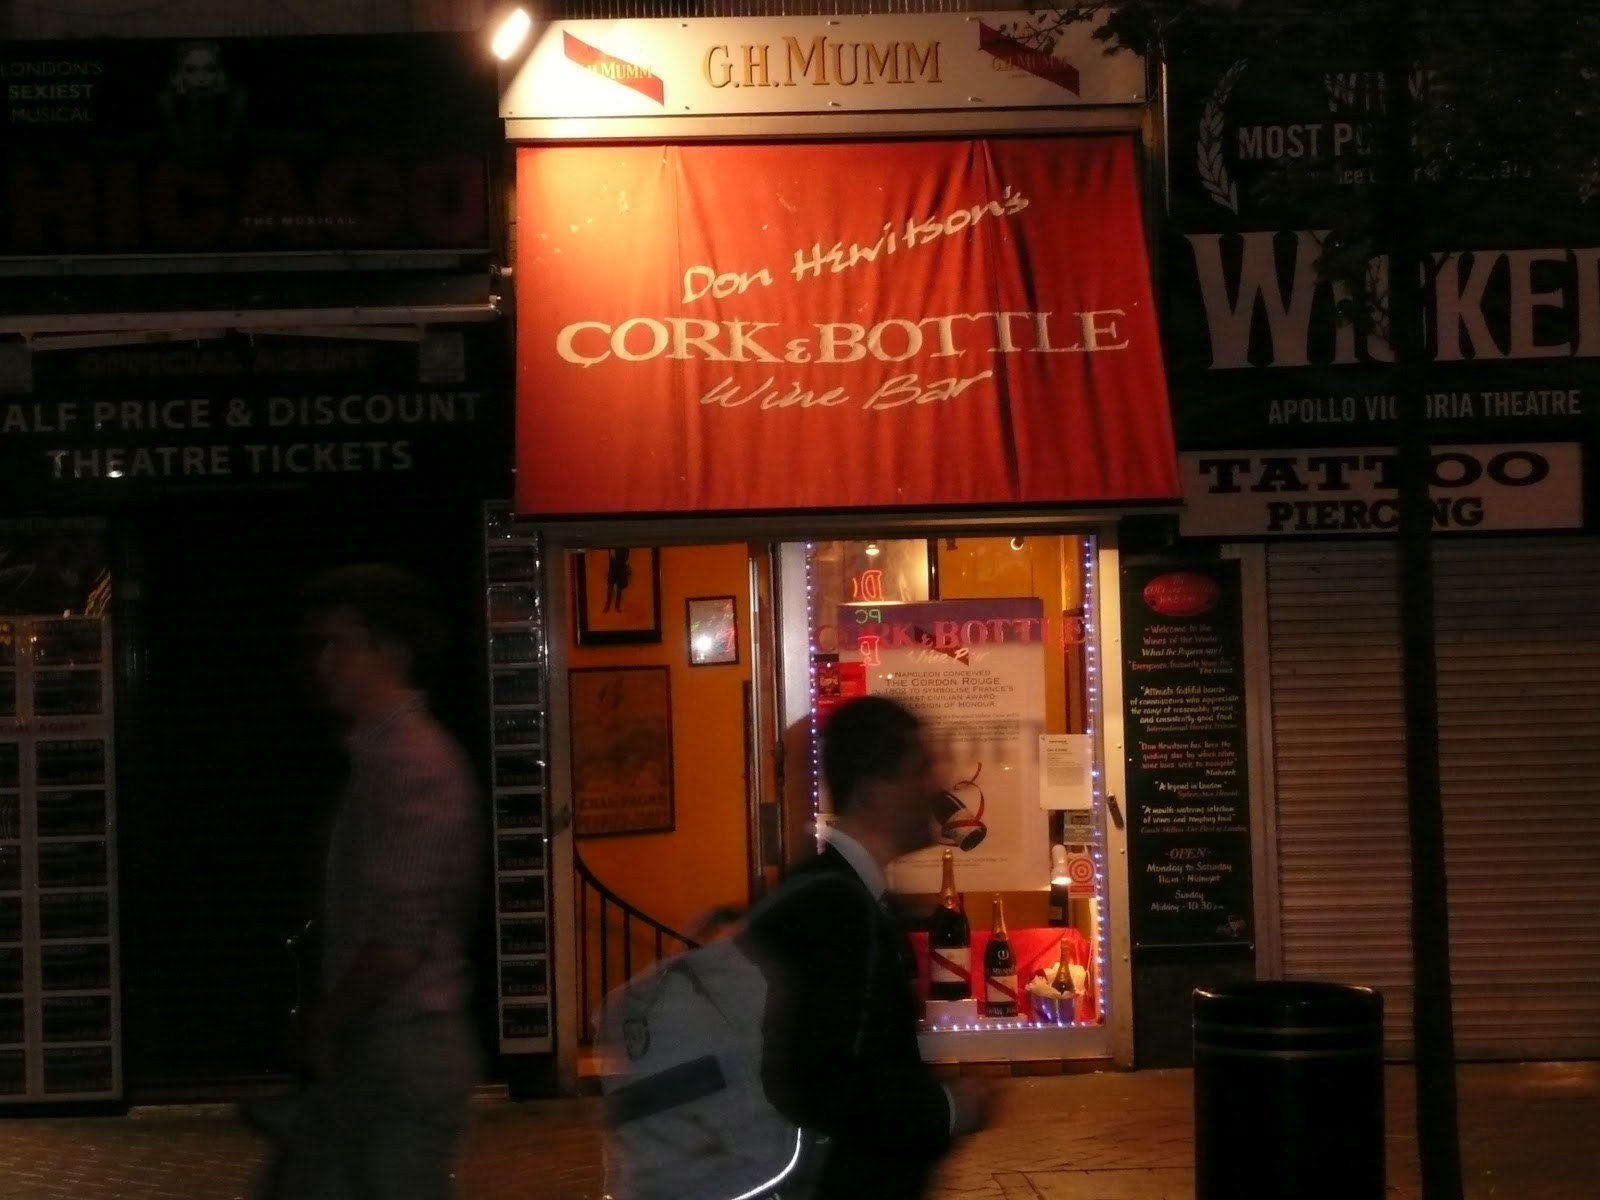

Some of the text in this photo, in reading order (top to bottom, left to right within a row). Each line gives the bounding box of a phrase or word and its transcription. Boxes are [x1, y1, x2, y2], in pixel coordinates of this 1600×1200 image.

[8, 84, 95, 100] SEXIEST
[11, 106, 95, 123] MUSICAL
[1238, 123, 1323, 160] MOST
[7, 152, 487, 248] HICAGO
[681, 264, 774, 305] Don
[556, 316, 787, 367] CORK
[813, 308, 1130, 365] BOTTLE
[701, 369, 993, 411] Wine Bar
[0, 391, 481, 433] ALF PRICE & DISCOUNT
[1269, 389, 1582, 425] APOLLO VICRIA THEATRE
[44, 440, 415, 480] THEATRE TICKETS
[1267, 496, 1485, 532] PIERCNG
[1141, 648, 1164, 657] What
[886, 677, 1001, 687] THE CORDON ROUGE
[923, 686, 970, 694] SYMBOLISE
[1139, 715, 1154, 724] and
[1197, 714, 1214, 723] good
[1143, 707, 1163, 716] range
[1167, 782, 1189, 792] legend
[1190, 782, 1197, 790] in
[1143, 816, 1151, 824] of
[1146, 861, 1232, 875] Monday to Saturday
[1187, 874, 1222, 884] Midnight
[1175, 889, 1204, 901] Sunday
[1150, 902, 1180, 912] Midday
